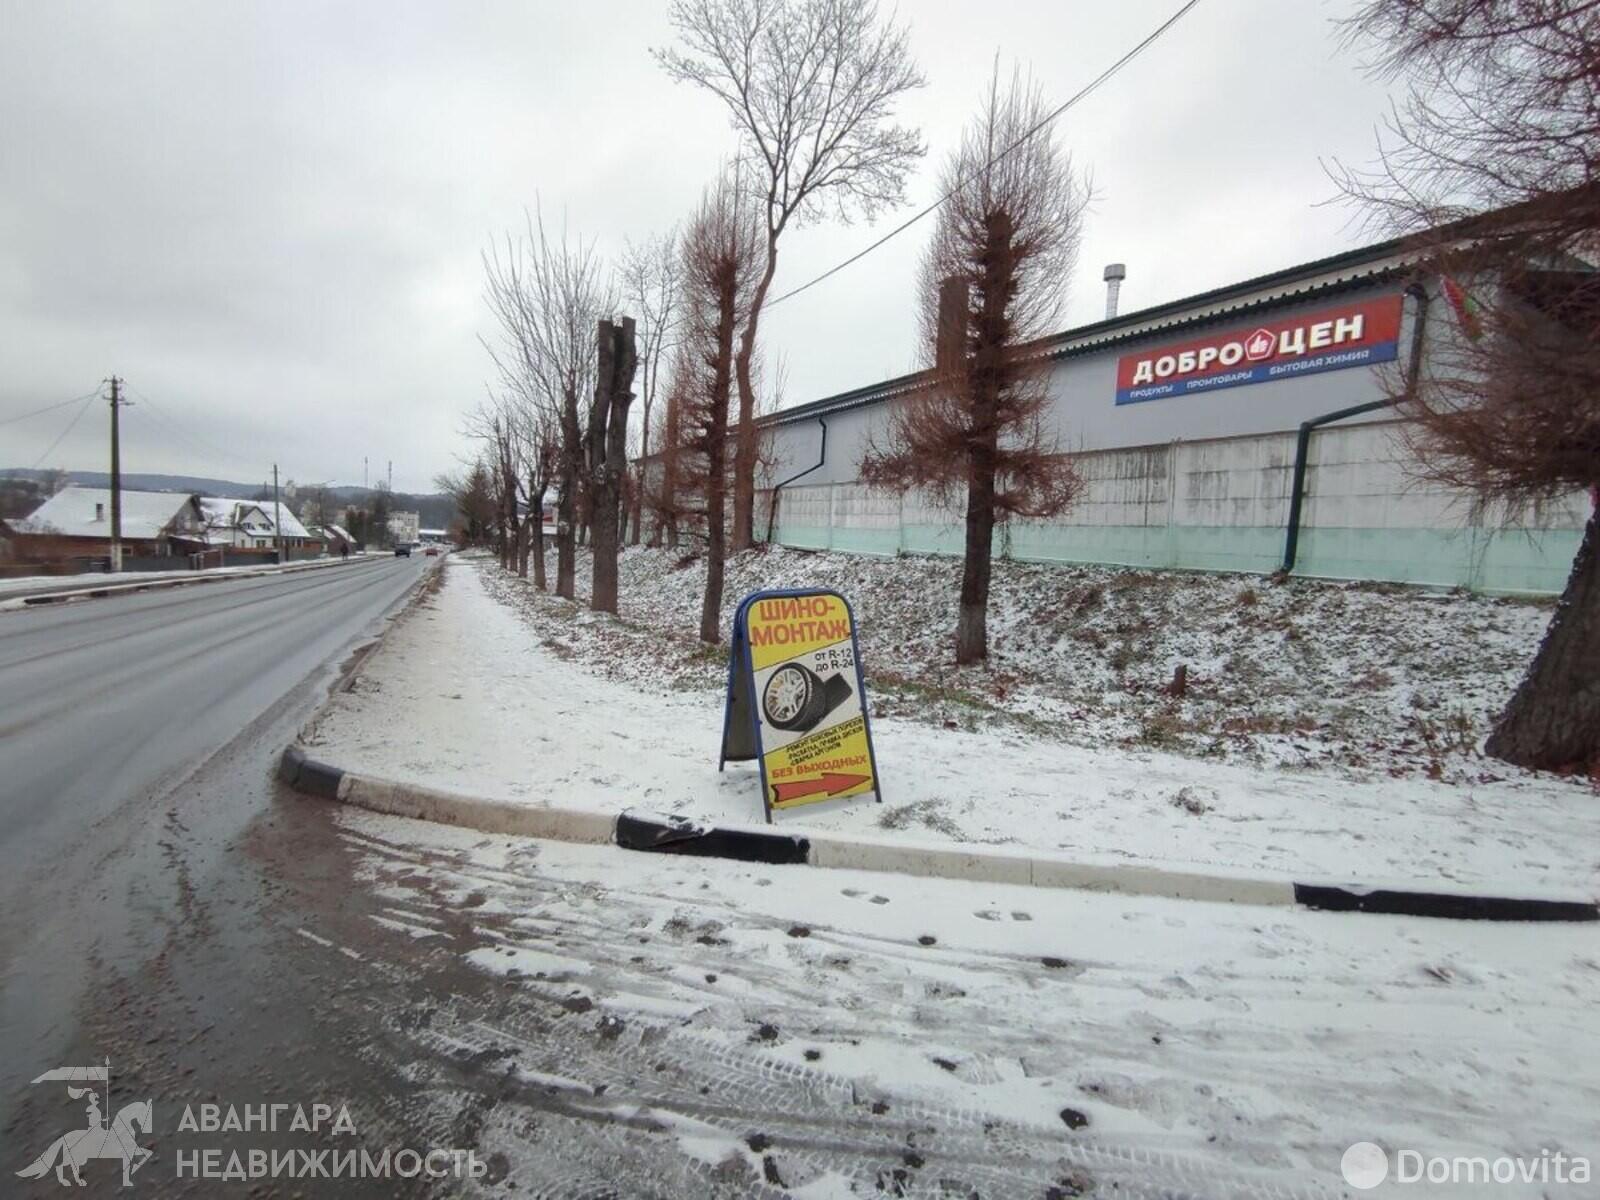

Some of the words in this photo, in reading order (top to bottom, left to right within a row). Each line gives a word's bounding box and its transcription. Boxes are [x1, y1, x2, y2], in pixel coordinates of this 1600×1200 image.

[1132, 342, 1243, 385] ДОБРО
[1279, 314, 1364, 355] ЦЕН
[1130, 384, 1174, 398] ПРОДУКТЫ
[1186, 370, 1253, 388] ПРОМТОВАРЫ
[1269, 358, 1323, 375] БЫТОВАЯ
[1325, 350, 1369, 365] ХИМИЯ
[759, 597, 836, 621] ШИНО-
[751, 618, 850, 647] МОНТАЖ
[828, 648, 852, 659] R-12
[831, 658, 854, 669] R-24
[772, 766, 793, 778] БЕЗ
[796, 754, 867, 774] ВЫХОДНЫХ
